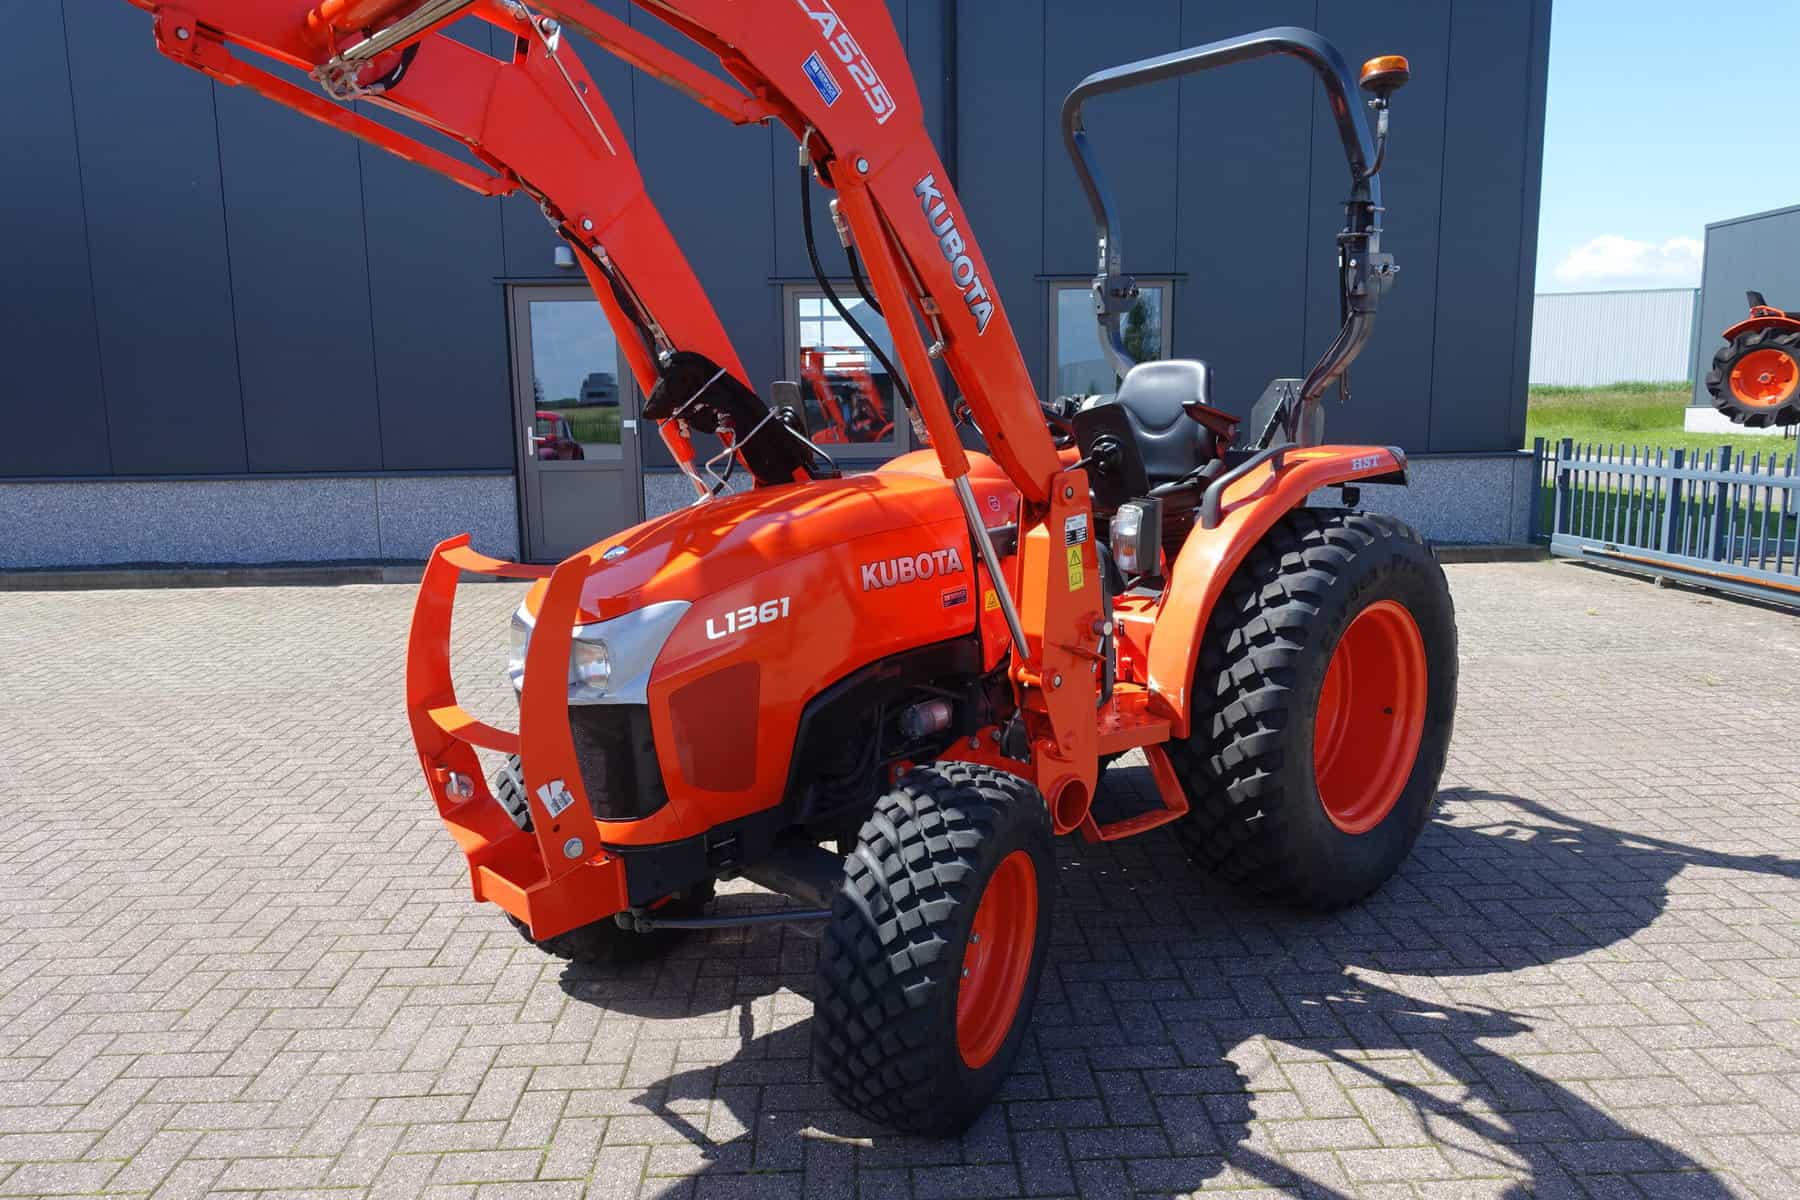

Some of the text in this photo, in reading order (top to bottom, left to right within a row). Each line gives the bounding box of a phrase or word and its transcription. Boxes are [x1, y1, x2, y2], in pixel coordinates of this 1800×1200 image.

[914, 172, 994, 336] KUBOTA
[1351, 454, 1380, 471] HST
[860, 547, 964, 592] KUBOTA
[705, 596, 790, 640] L1361
